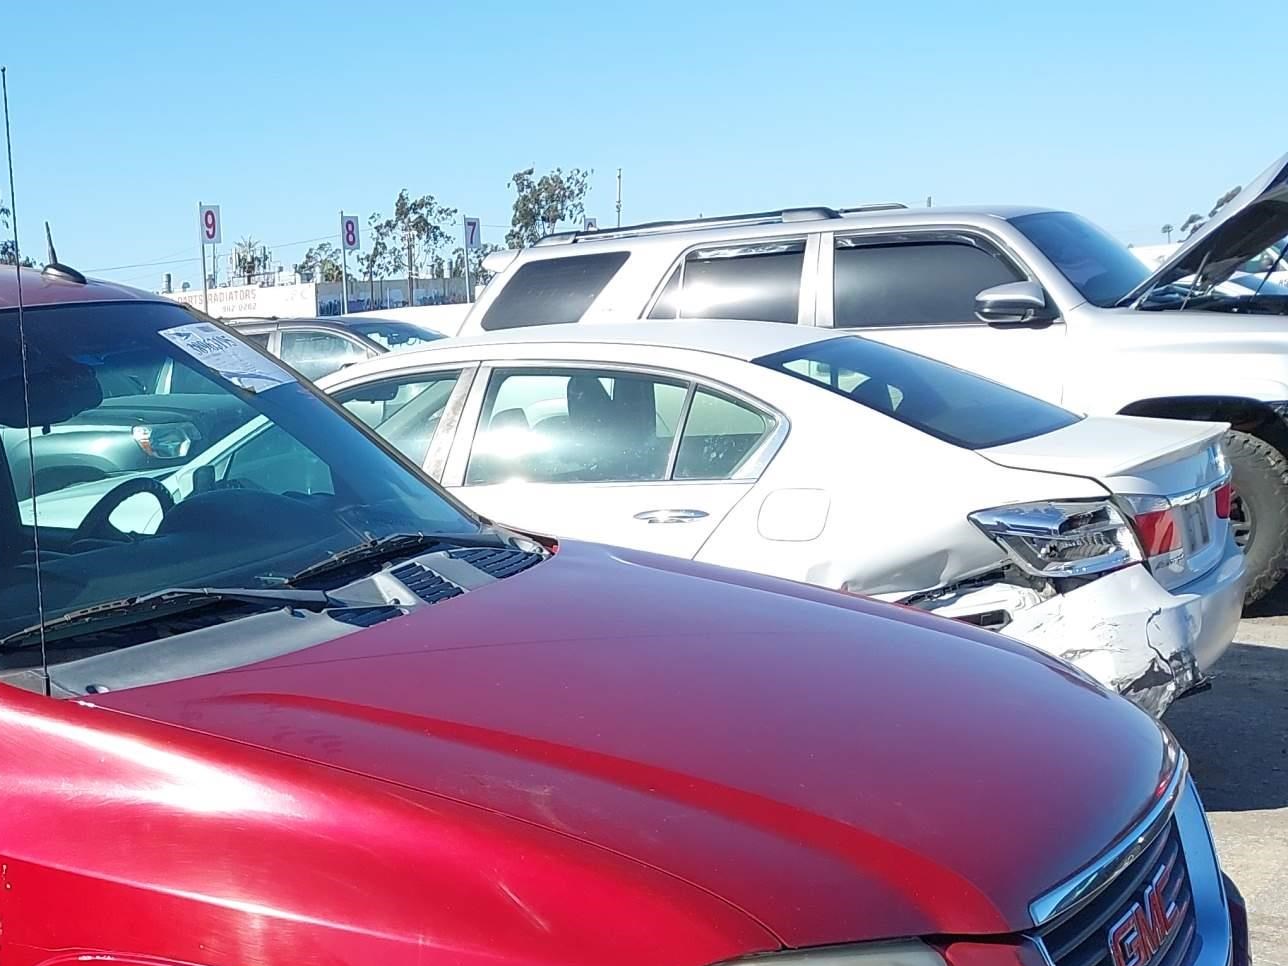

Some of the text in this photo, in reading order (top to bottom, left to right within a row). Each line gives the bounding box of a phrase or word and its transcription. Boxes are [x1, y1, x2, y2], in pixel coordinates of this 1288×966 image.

[204, 209, 216, 240] 9
[345, 219, 356, 246] 8
[467, 221, 477, 245] 7
[207, 289, 257, 304] RADIATORS
